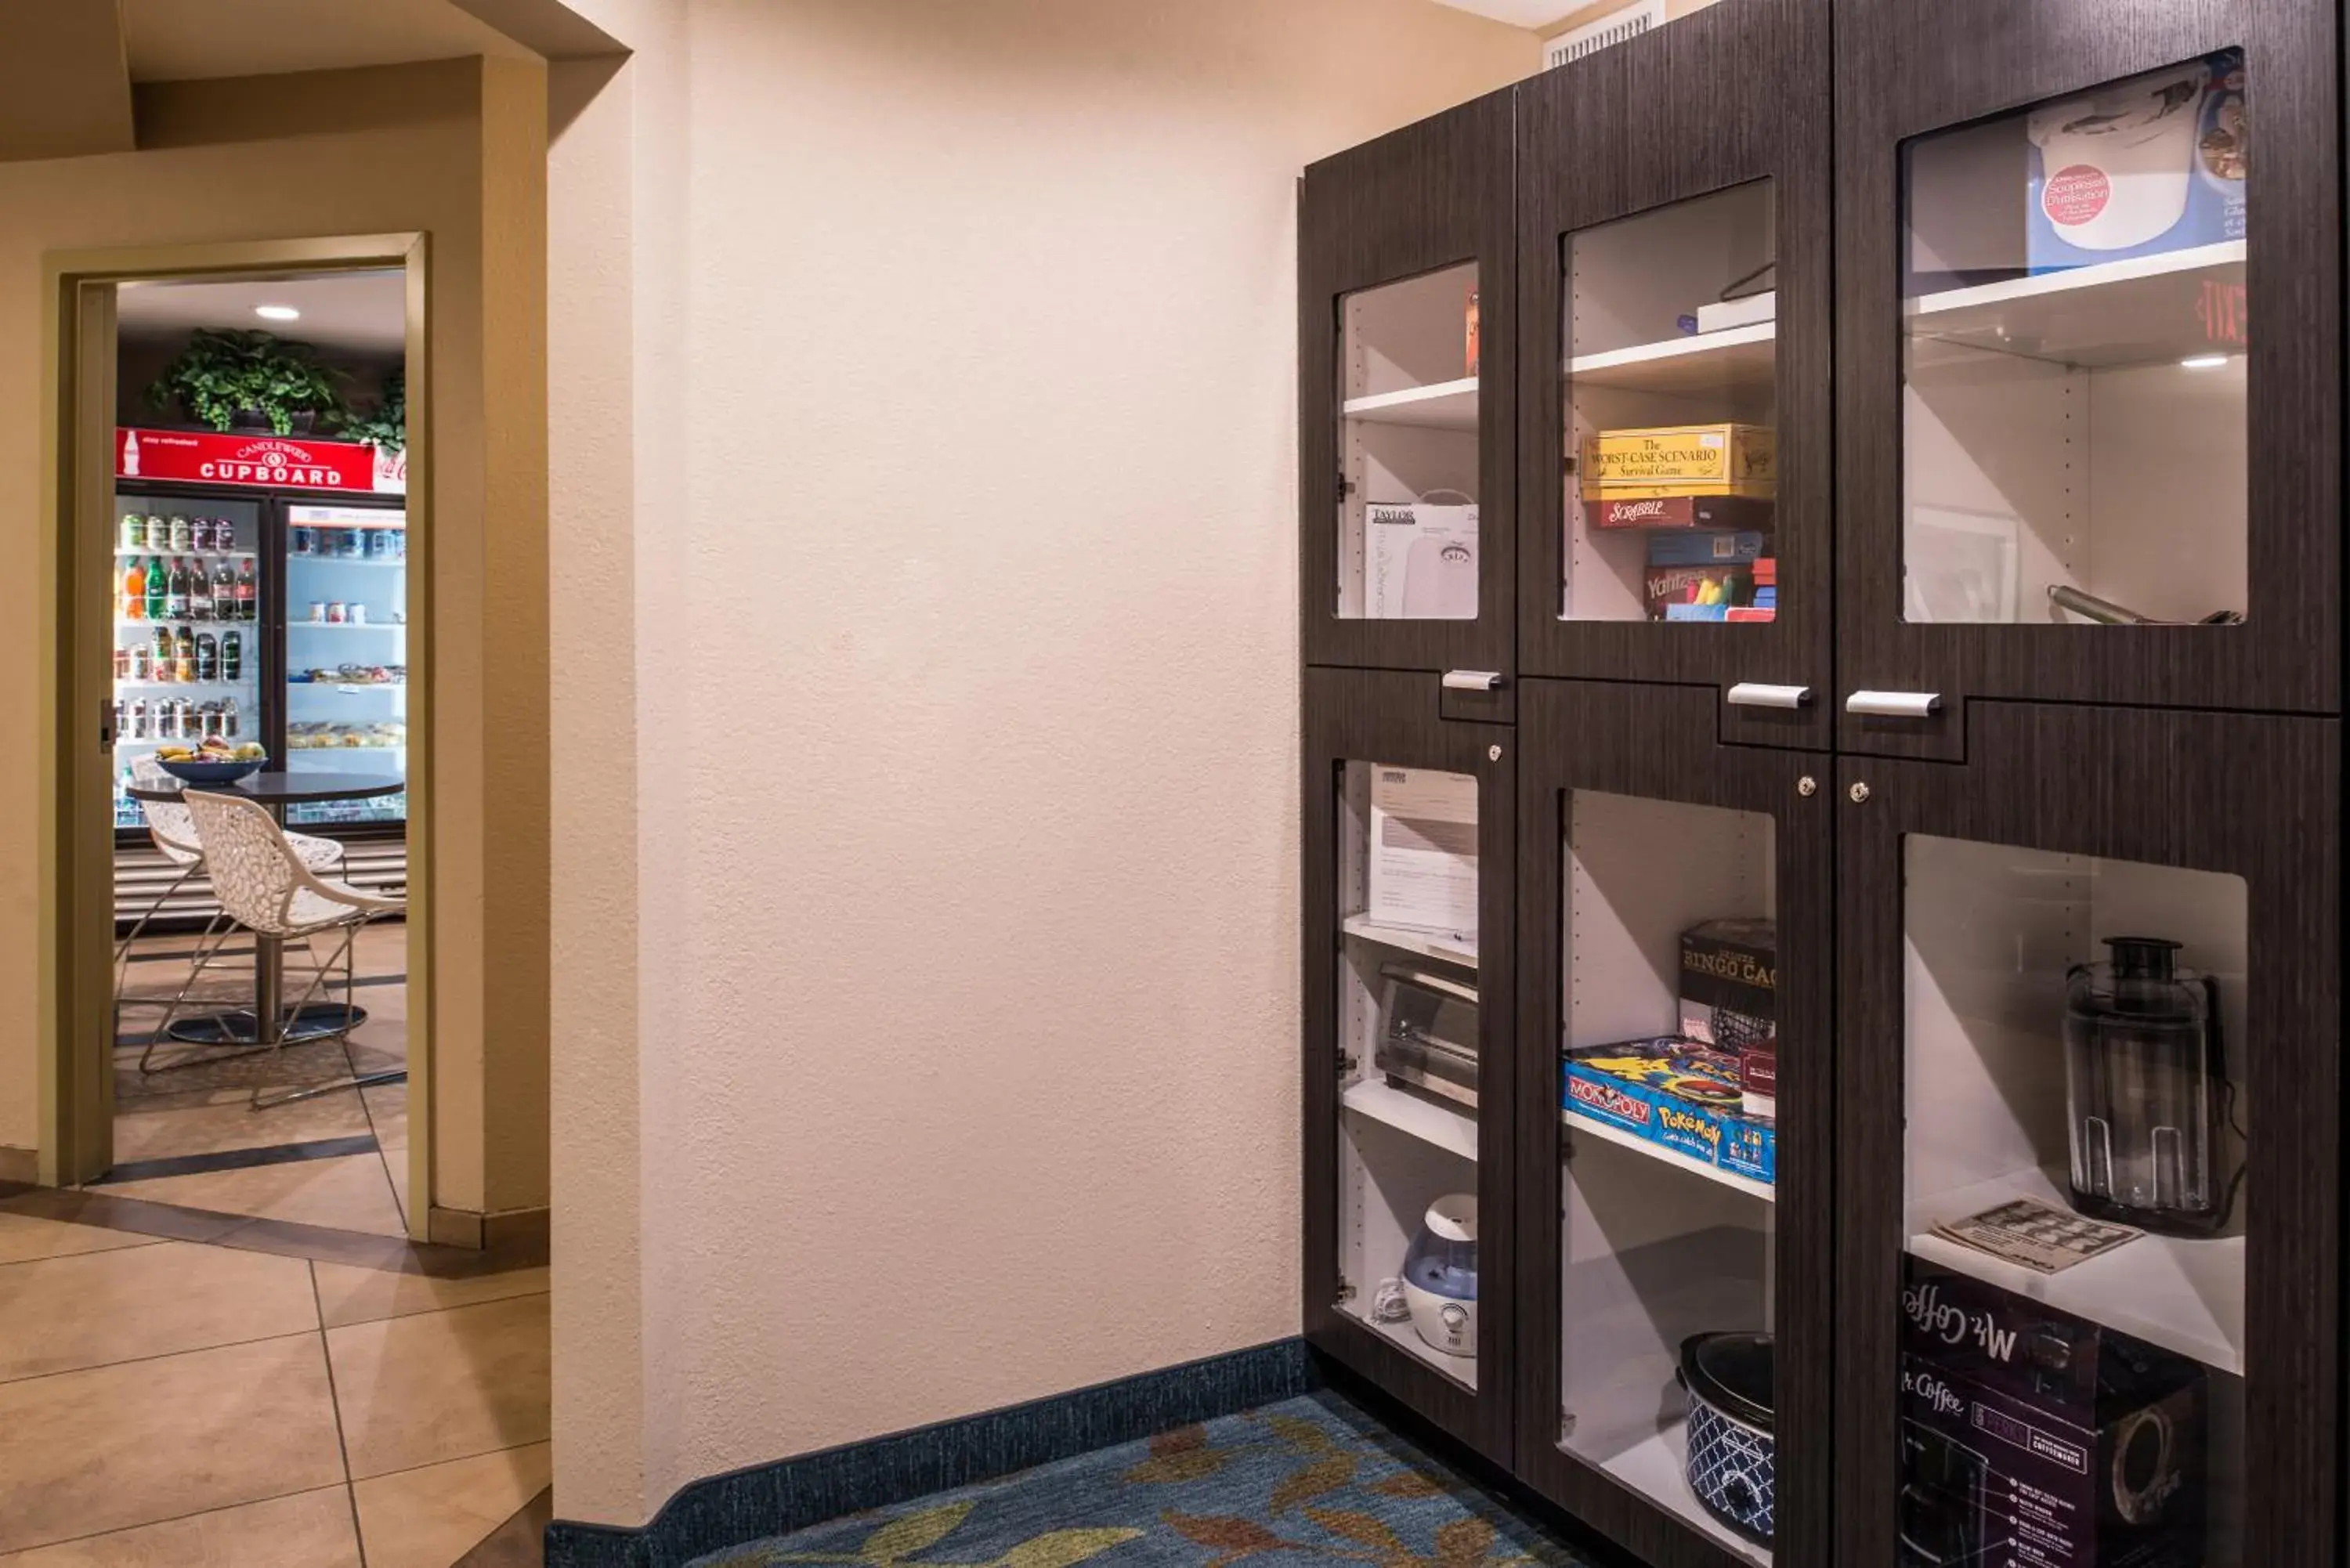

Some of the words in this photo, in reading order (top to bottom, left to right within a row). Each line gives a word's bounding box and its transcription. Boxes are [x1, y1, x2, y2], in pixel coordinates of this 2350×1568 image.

[237, 440, 312, 463] CANDLEWOOD
[1643, 439, 1661, 450] The
[1592, 452, 1657, 464] WORST-CASE
[1658, 449, 1716, 463] SCENARIO
[200, 462, 342, 486] CUPBOARD
[1620, 463, 1653, 477] Survival
[1655, 464, 1682, 476] Game
[1373, 508, 1415, 520] TAYLOR
[1683, 949, 1738, 977] BINGO
[1570, 1081, 1647, 1119] MONOPOLY
[1970, 1313, 2017, 1363] Mr.
[1916, 1373, 1965, 1412] Coffee
